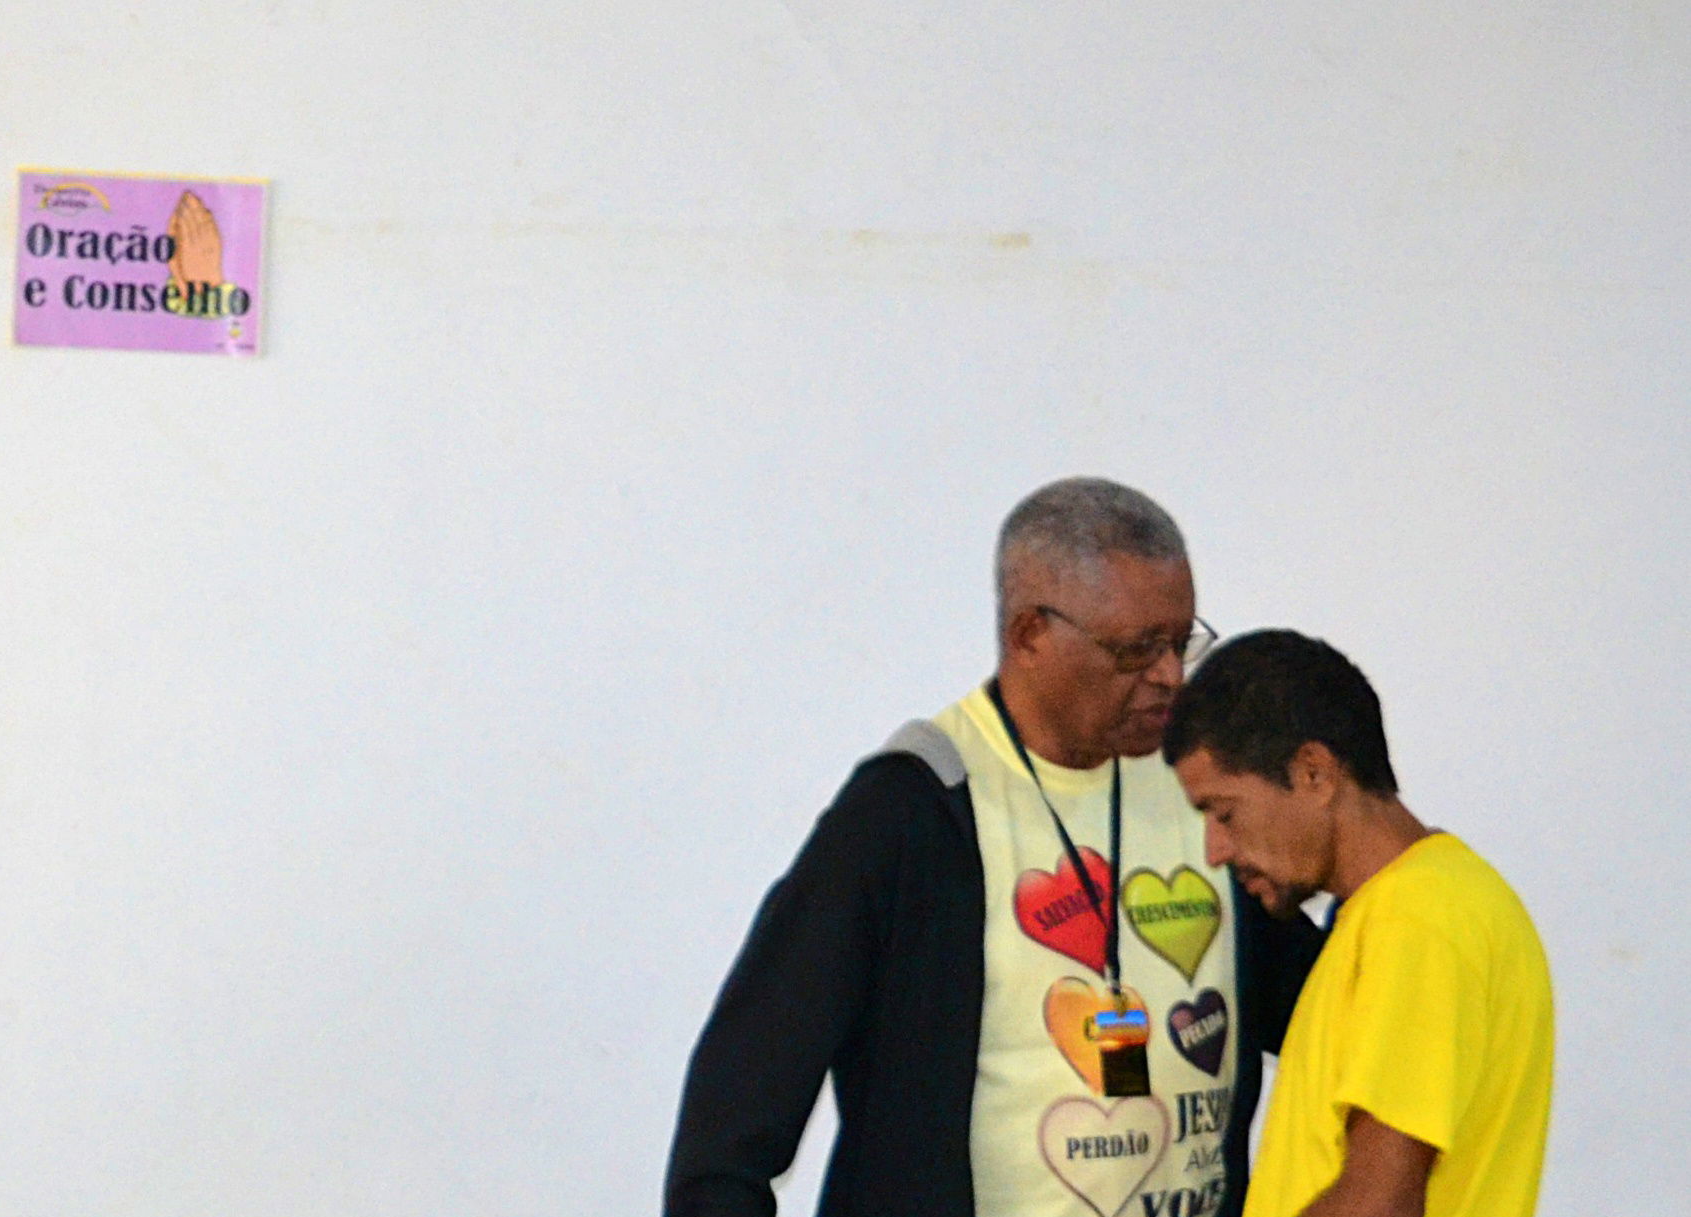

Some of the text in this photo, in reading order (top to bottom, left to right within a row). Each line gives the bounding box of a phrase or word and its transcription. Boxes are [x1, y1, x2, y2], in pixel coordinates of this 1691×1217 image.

[25, 221, 177, 266] Oração
[24, 274, 251, 317] e Conselho
[1066, 1129, 1150, 1160] PERDÃO
